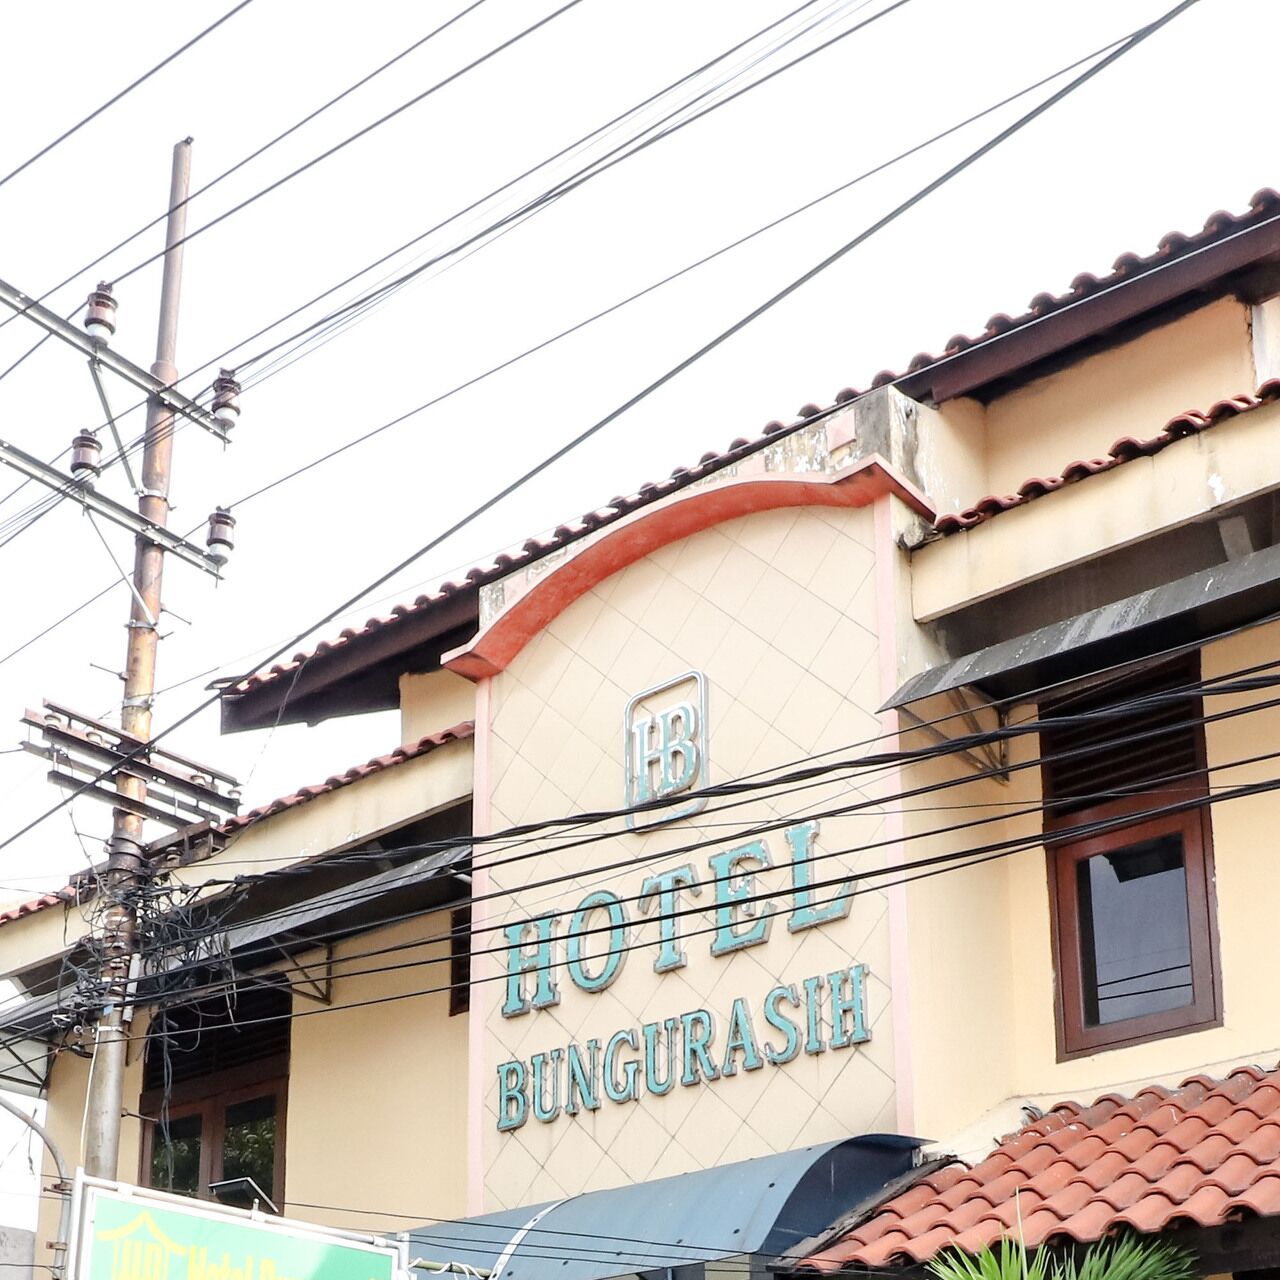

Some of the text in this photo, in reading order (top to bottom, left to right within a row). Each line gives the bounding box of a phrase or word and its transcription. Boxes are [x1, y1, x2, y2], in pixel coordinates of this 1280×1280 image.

[634, 701, 700, 801] HB
[500, 820, 860, 1019] HOTEL
[497, 962, 872, 1132] BUNGURASIH
